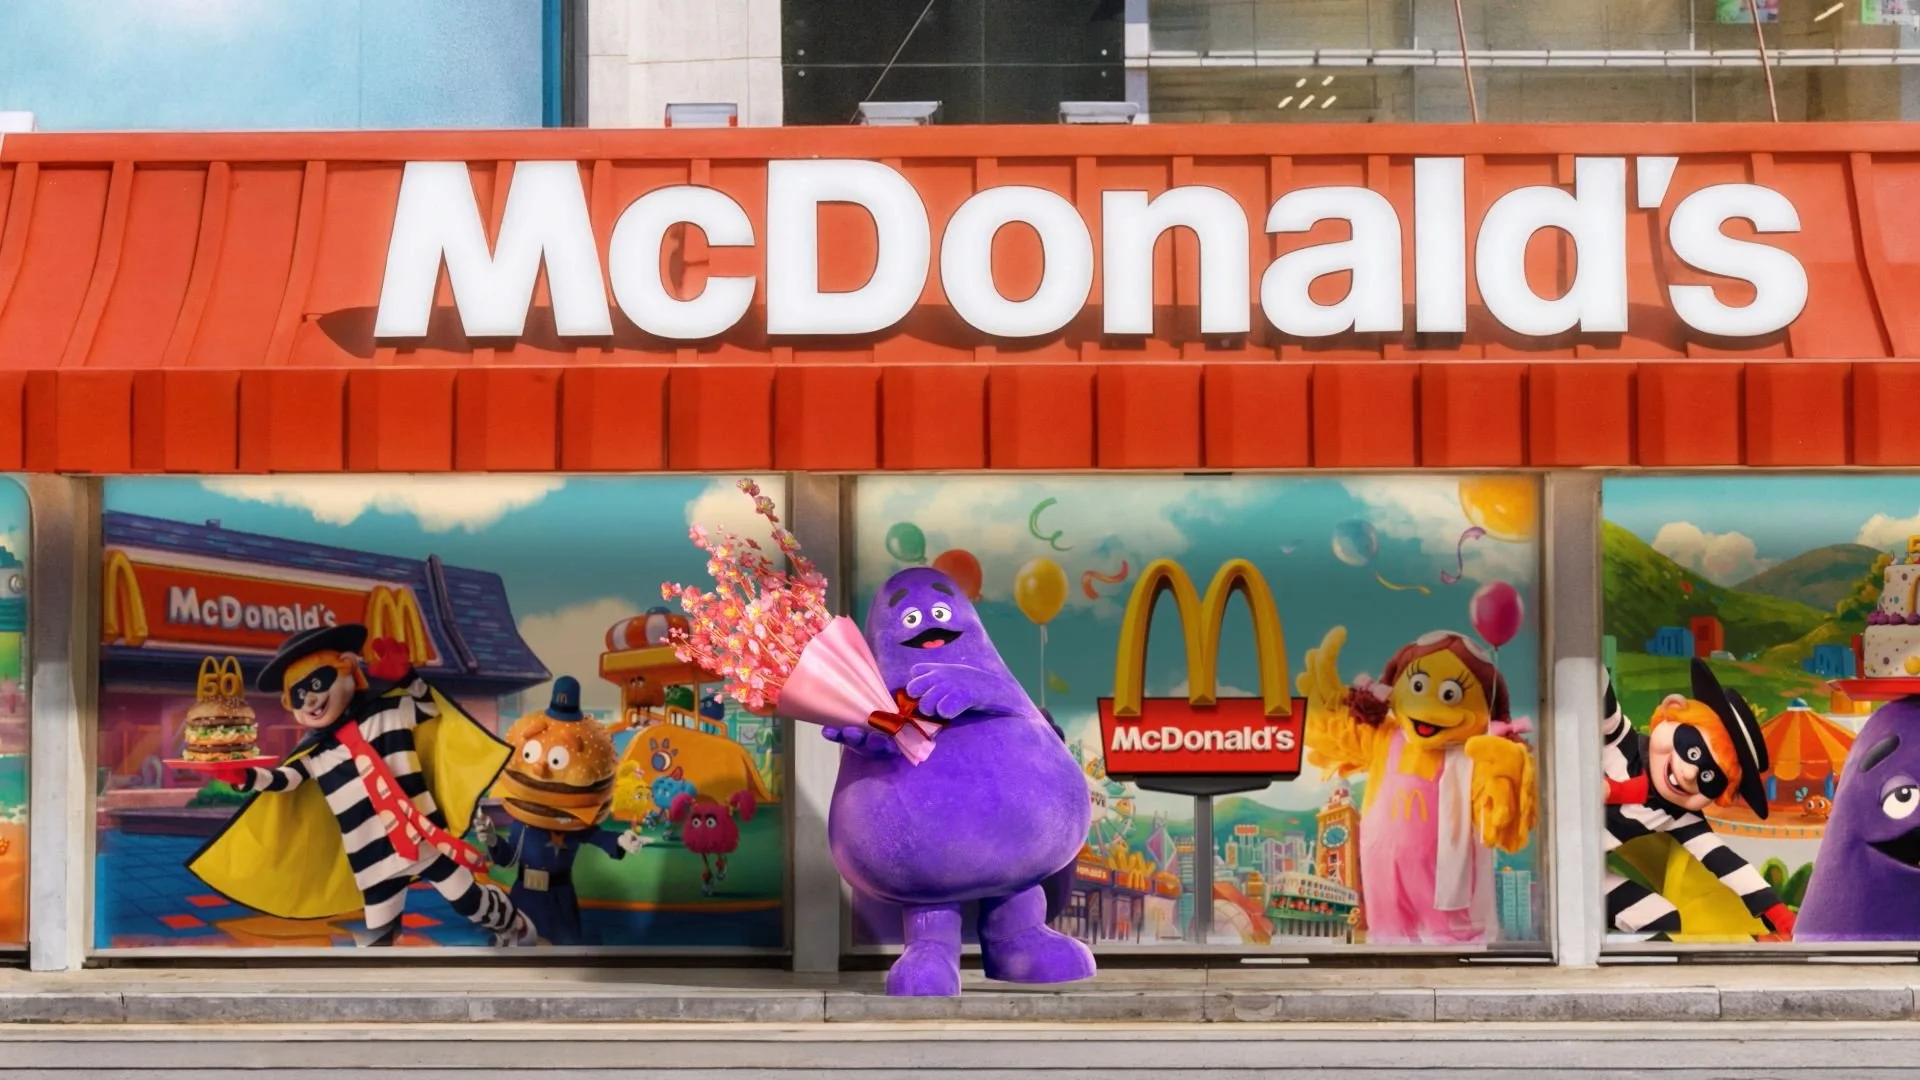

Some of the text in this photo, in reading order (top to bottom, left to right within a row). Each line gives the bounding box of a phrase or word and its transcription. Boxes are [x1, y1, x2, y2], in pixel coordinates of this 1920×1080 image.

[374, 157, 1808, 338] McDonald's
[169, 586, 338, 632] McDonald's
[203, 673, 238, 697] 50
[1112, 726, 1295, 752] McDonald's
